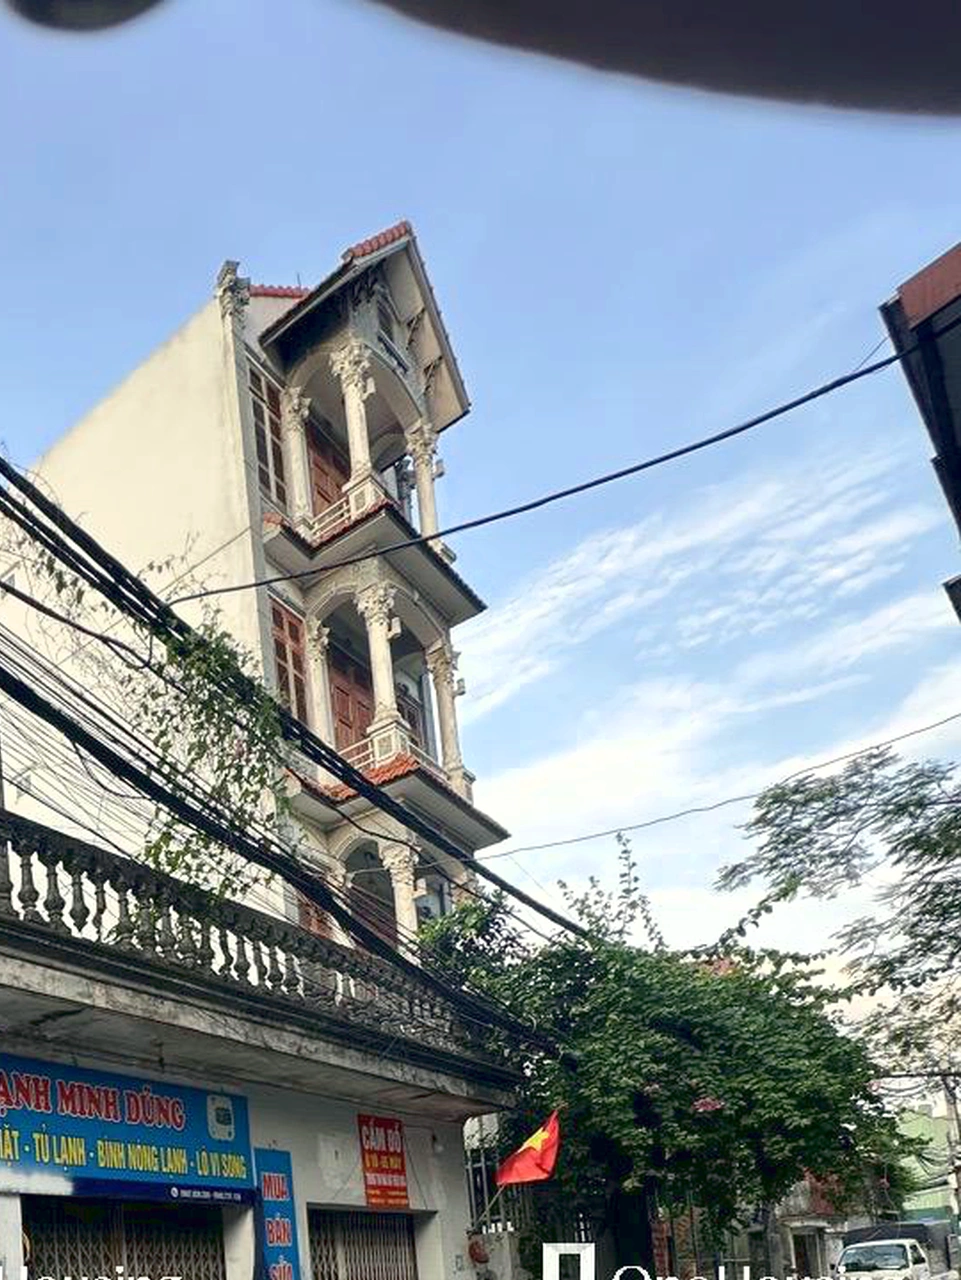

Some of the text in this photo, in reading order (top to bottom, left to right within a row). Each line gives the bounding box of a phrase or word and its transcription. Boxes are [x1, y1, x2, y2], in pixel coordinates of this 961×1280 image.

[56, 1079, 121, 1123] MINH
[32, 1124, 50, 1163] TỦ
[52, 1135, 86, 1171] LẠNH
[162, 1147, 189, 1178] LẠNH
[262, 1172, 289, 1200] MUA
[265, 1213, 292, 1246] BÁN
